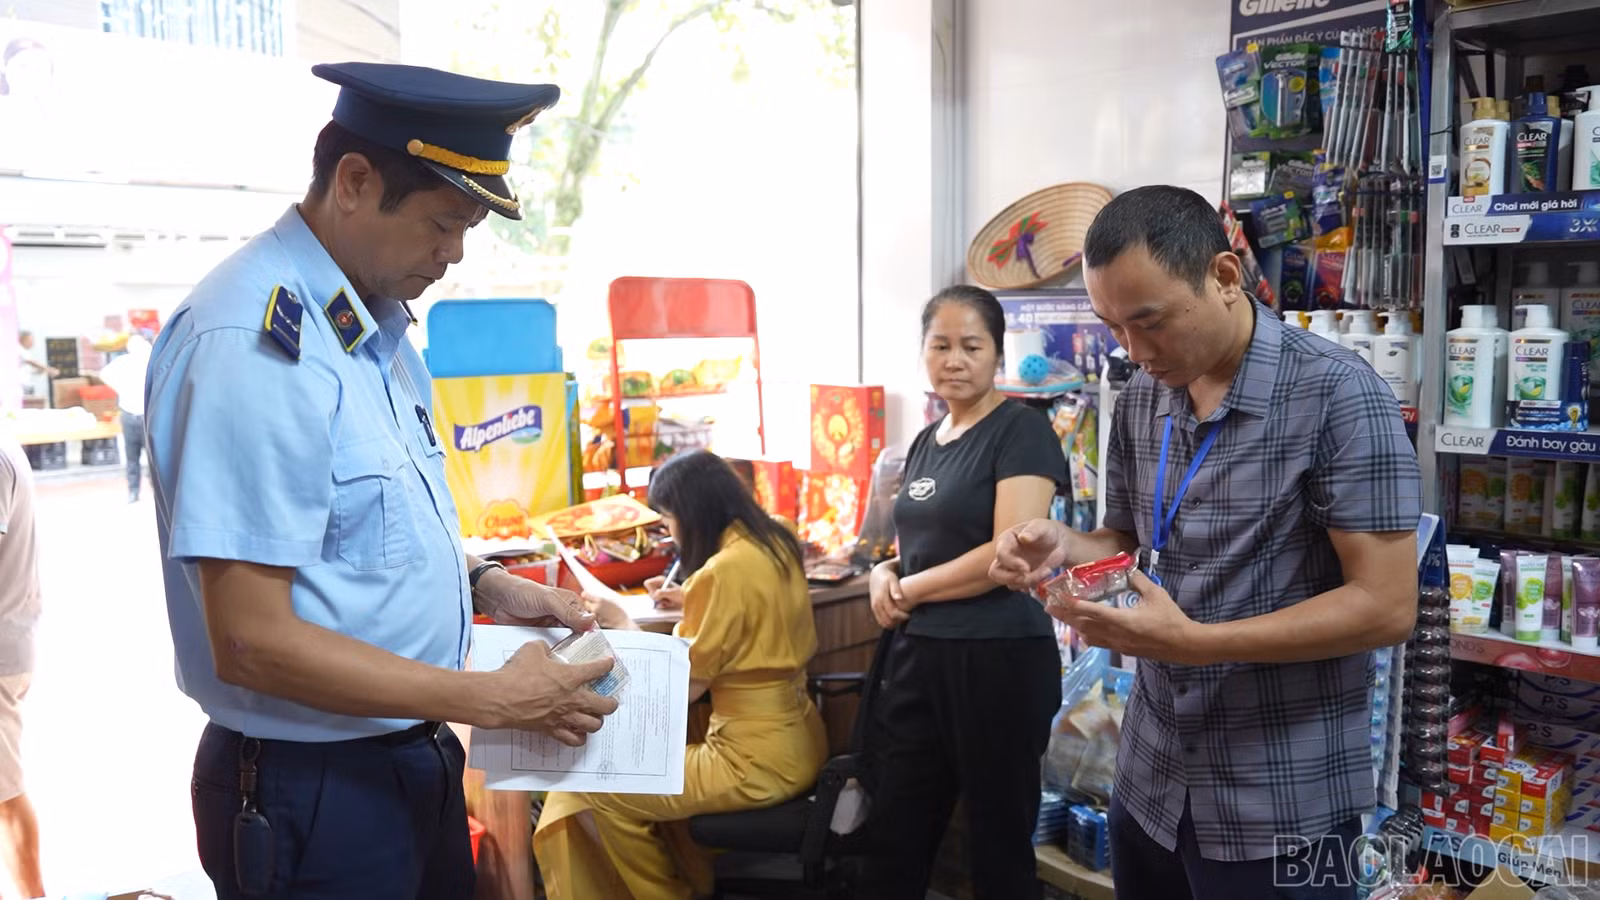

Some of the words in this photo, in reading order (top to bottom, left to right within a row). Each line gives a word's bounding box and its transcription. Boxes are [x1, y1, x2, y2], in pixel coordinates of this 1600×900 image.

[1517, 132, 1547, 142] CLEAR
[1452, 203, 1483, 215] CLEAR
[1493, 202, 1518, 212] Chai
[1519, 200, 1539, 211] mới
[1541, 199, 1558, 211] giá
[1464, 223, 1501, 235] CLEAR
[1448, 345, 1477, 355] CLEAR
[1515, 345, 1549, 356] CLEAR
[460, 407, 536, 451] Alpenliebe
[1441, 432, 1485, 448] CLEAR
[1506, 435, 1539, 448] Đánh
[1542, 437, 1567, 452] bay
[1569, 438, 1596, 454] gàu
